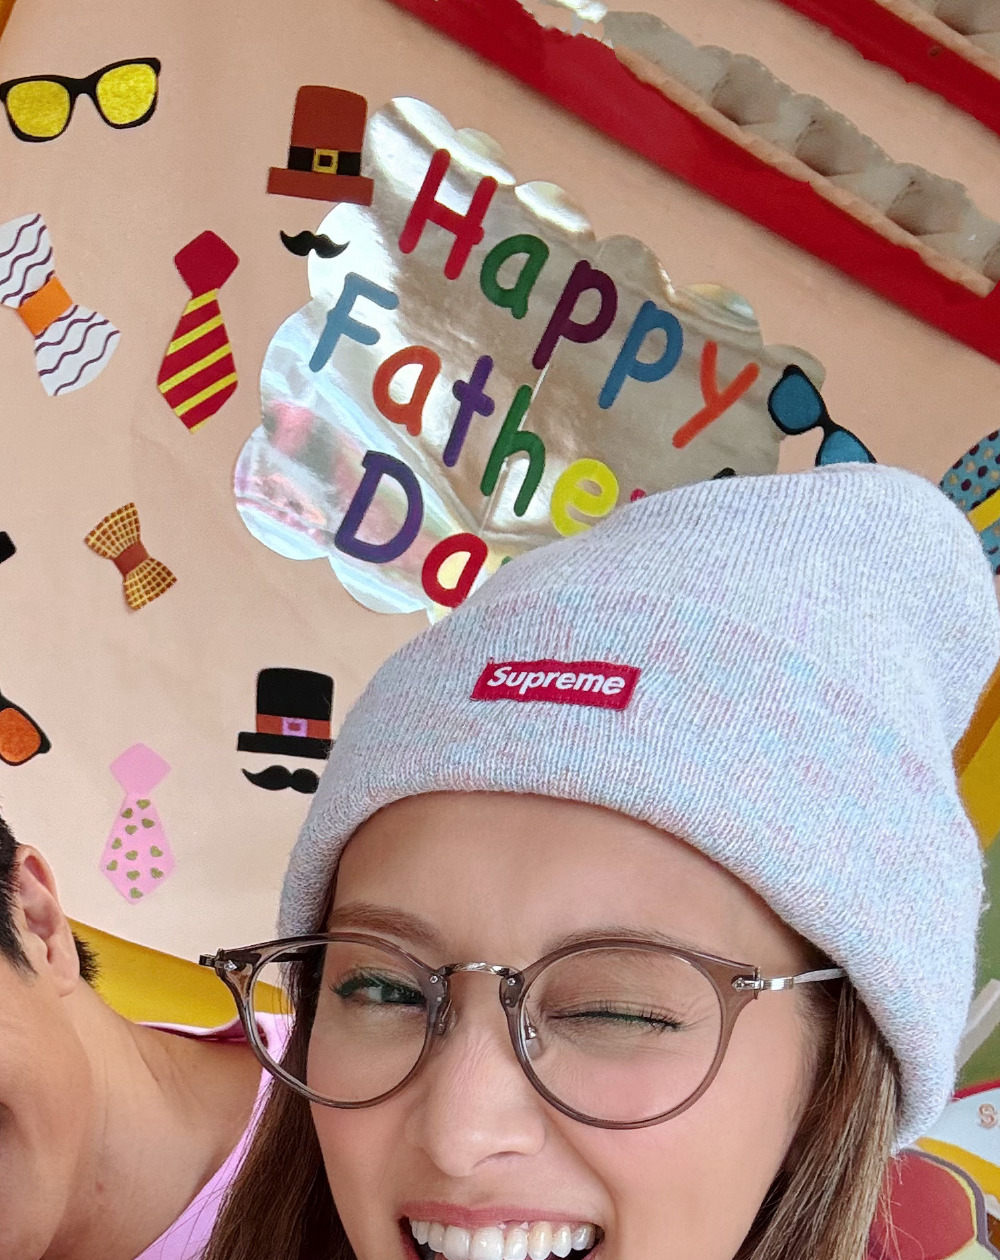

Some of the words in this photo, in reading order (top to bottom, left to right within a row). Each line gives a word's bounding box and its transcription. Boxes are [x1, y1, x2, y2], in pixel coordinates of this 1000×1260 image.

[308, 272, 647, 537] Fathe
[398, 148, 760, 449] Happy
[334, 450, 513, 609] Da
[486, 666, 626, 695] Supreme
